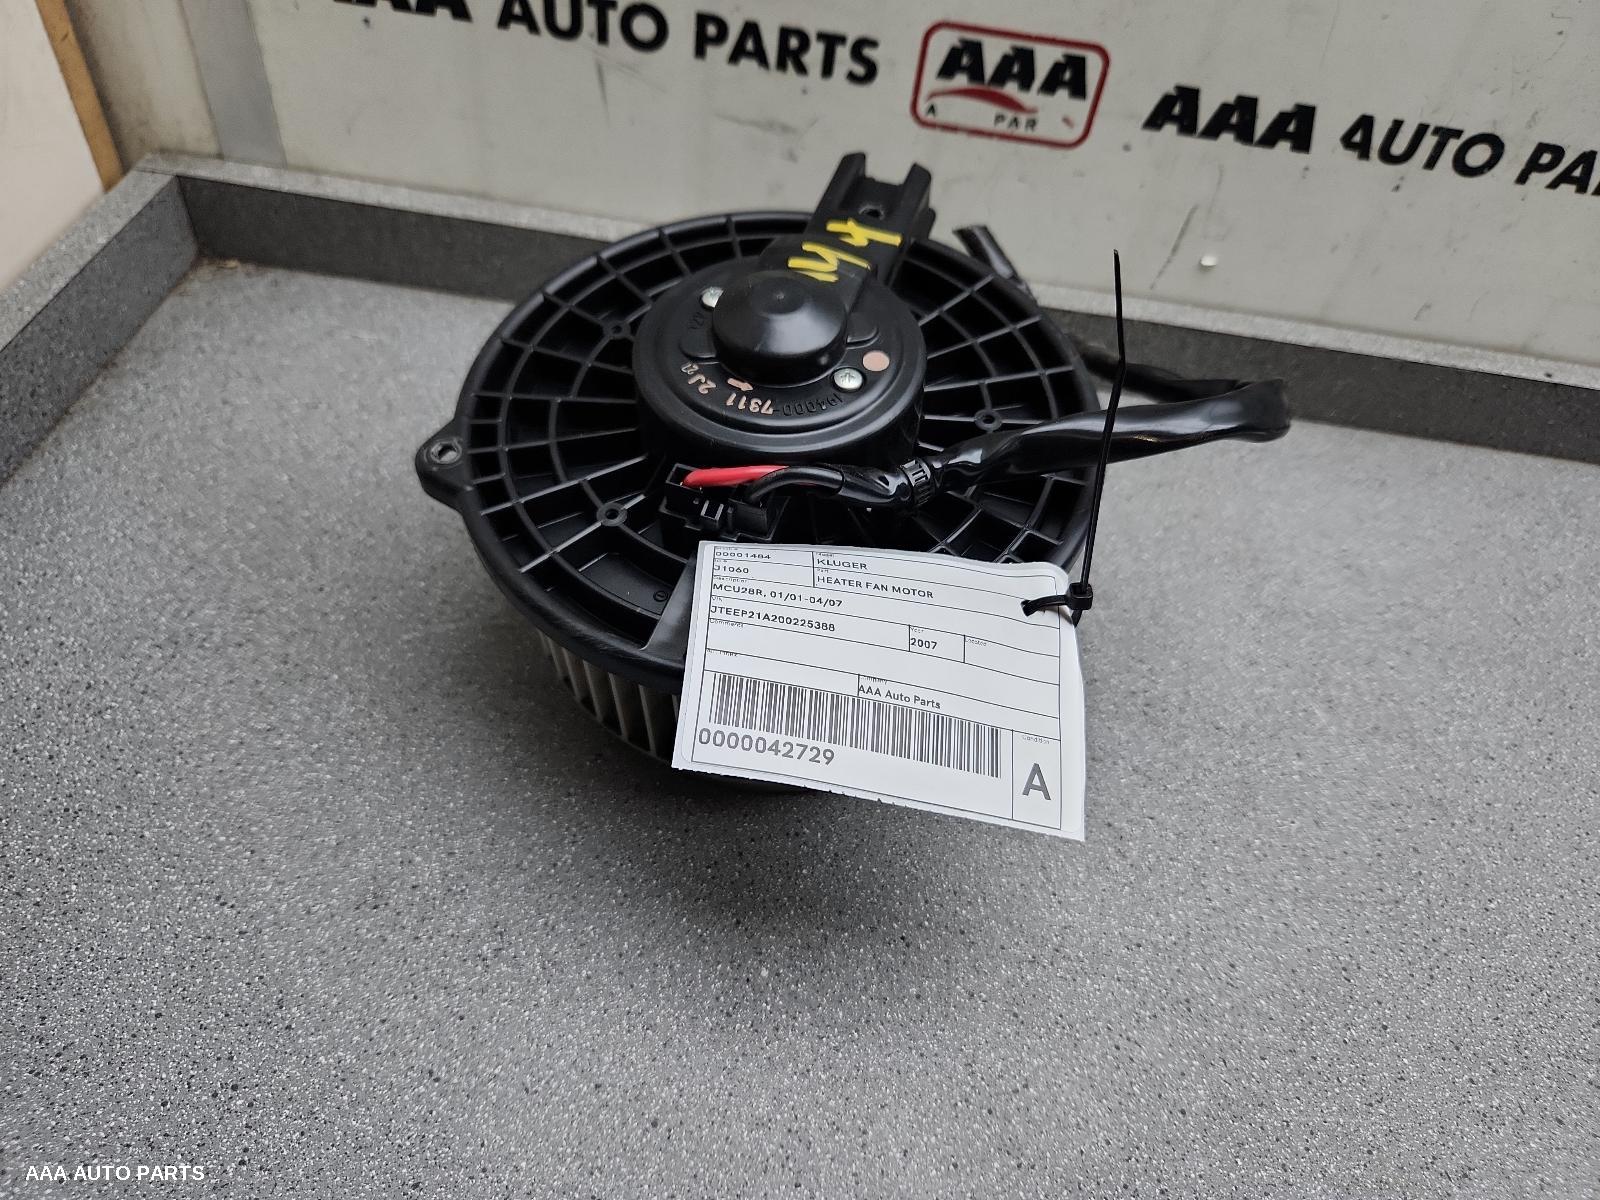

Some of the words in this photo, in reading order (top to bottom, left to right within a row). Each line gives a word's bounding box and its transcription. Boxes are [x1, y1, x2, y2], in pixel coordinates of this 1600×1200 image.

[497, 0, 669, 53] AUTO
[694, 11, 880, 86] PARTS
[936, 36, 1087, 101] AAA
[1141, 84, 1316, 155] AAA
[1514, 142, 1600, 197] PA
[714, 564, 750, 574] J1060
[817, 558, 868, 571] KLUGER
[712, 583, 767, 598] MCU28R,
[770, 591, 843, 608] 01/01-04/07
[817, 575, 863, 589] HEATER
[866, 582, 889, 593] FAN
[892, 585, 934, 599] MOTOR
[710, 605, 836, 632] JTEEP21A200225388
[910, 637, 938, 650] 2007
[858, 684, 882, 698] AAA
[885, 690, 911, 703] Auto
[913, 694, 941, 710] Parts
[698, 727, 835, 766] 0000042729
[1022, 762, 1052, 801] A
